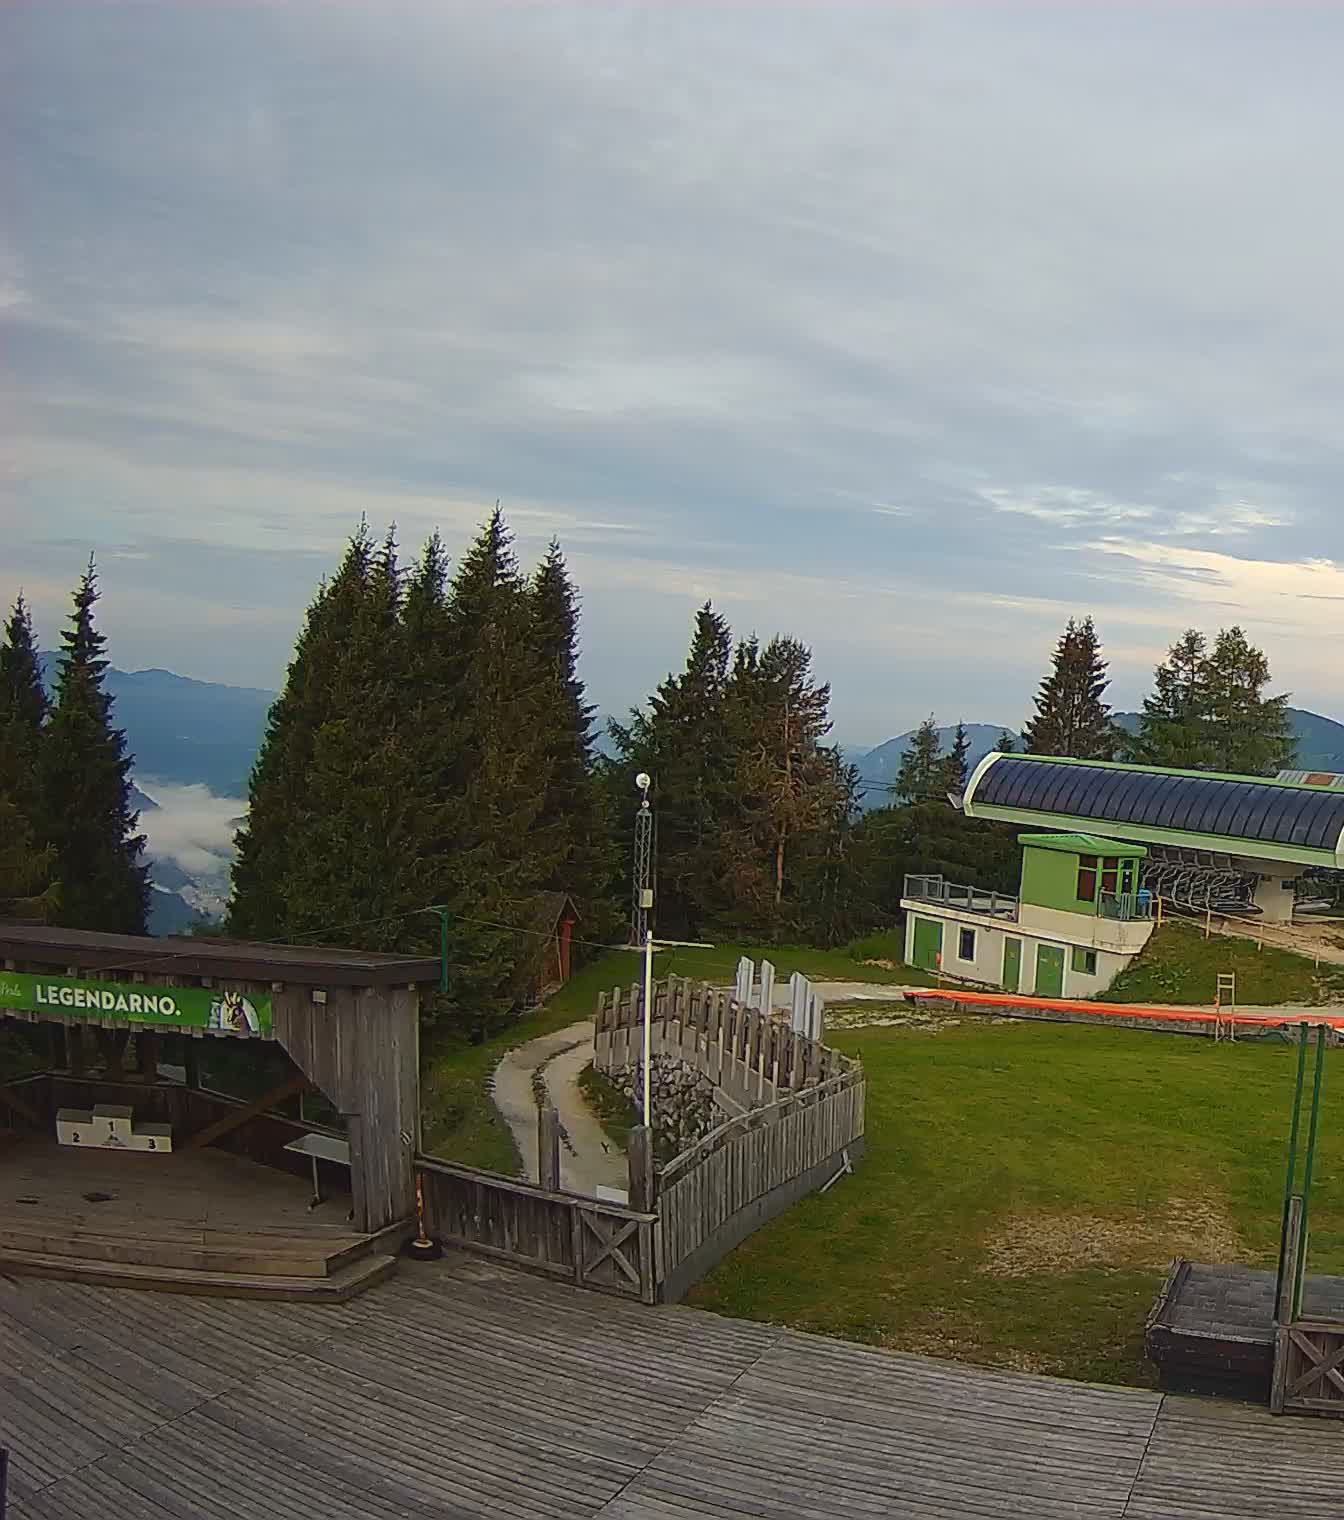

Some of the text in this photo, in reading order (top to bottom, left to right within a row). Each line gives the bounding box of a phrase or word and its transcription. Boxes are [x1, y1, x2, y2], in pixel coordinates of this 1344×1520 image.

[35, 984, 183, 1017] LEGENDARNO.
[107, 1120, 115, 1132] 1
[72, 1132, 80, 1143] 2
[148, 1138, 156, 1149] 3
